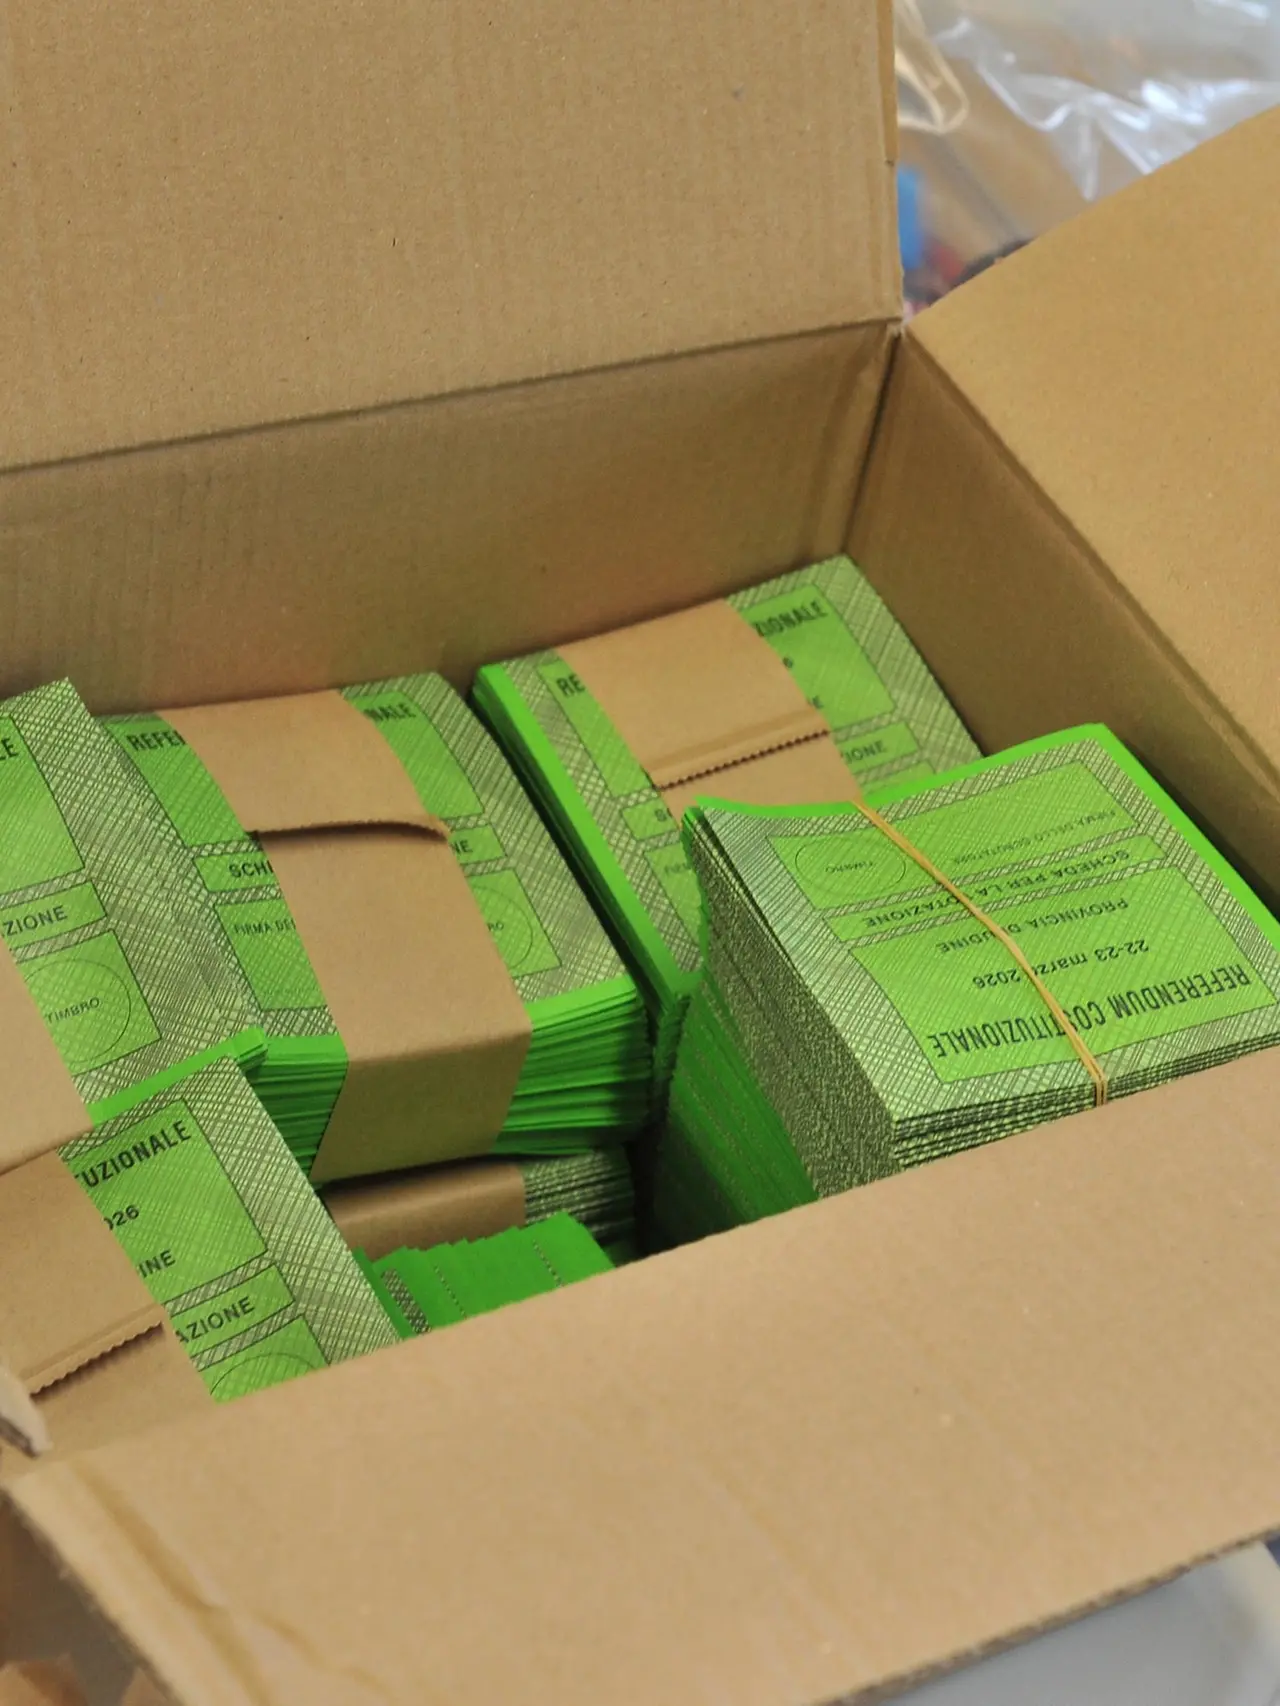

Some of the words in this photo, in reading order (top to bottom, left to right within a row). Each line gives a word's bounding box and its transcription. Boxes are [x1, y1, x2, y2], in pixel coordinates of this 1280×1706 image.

[1051, 850, 1130, 878] SCHEDA
[975, 883, 1003, 897] LA
[1007, 872, 1047, 890] PER
[1028, 897, 1129, 929] PROVINCIA
[1094, 939, 1150, 962] 22-23
[973, 968, 1021, 990] 2026
[1107, 963, 1251, 1020] REFERENDUM
[44, 997, 99, 1023] TIMBRO
[74, 1120, 191, 1187] UZIONALE
